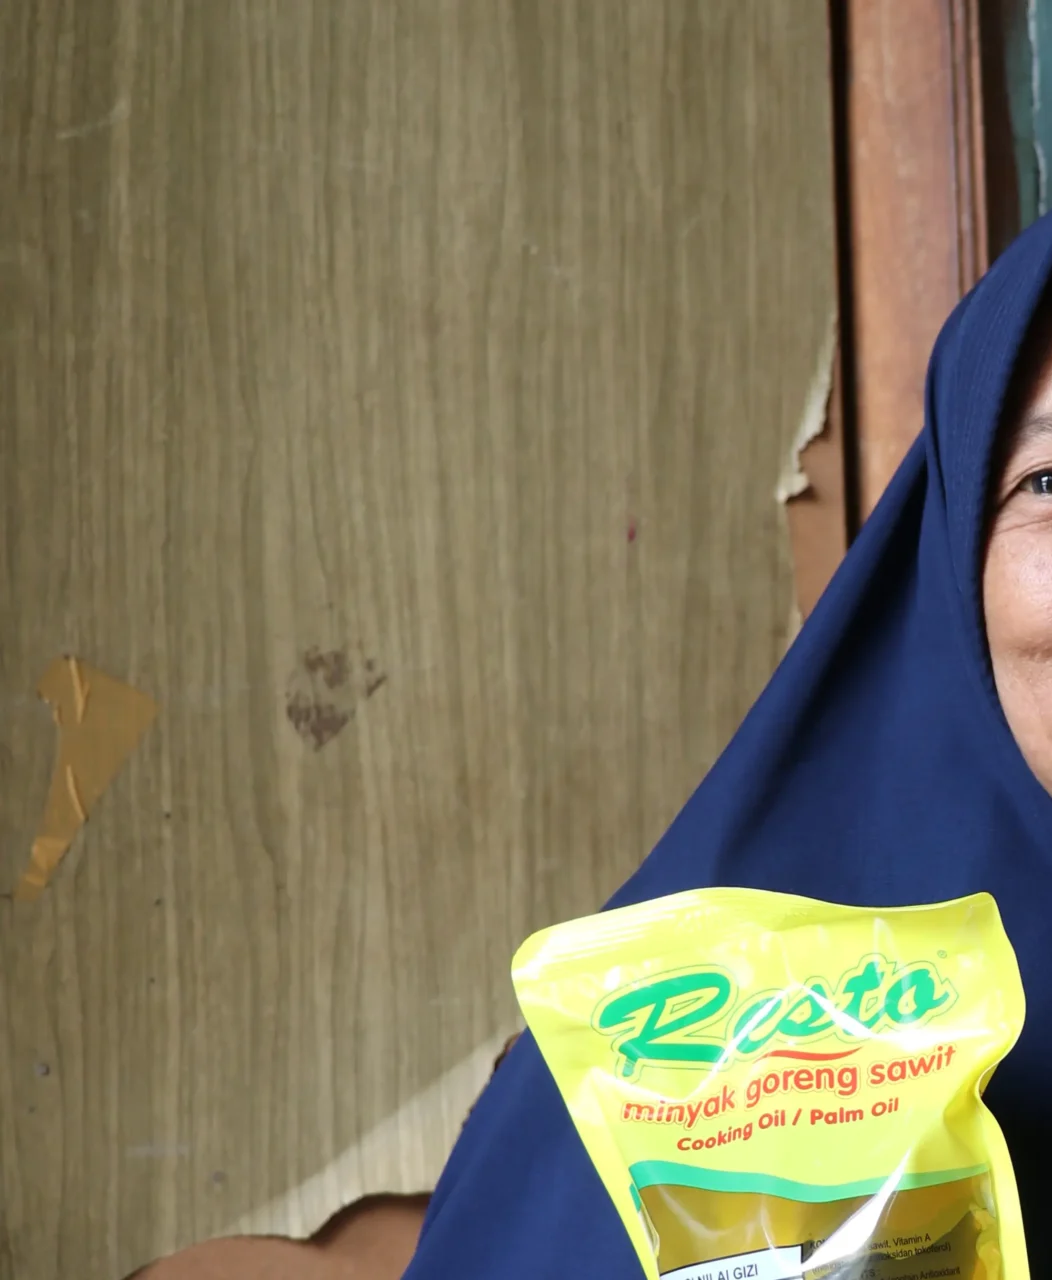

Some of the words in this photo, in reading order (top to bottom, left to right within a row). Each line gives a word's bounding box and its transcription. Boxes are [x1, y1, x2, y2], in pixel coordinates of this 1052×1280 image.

[598, 961, 949, 1077] Resto
[623, 1085, 735, 1128] minyak
[746, 1066, 857, 1108] goreng
[870, 1045, 956, 1084] sawit
[677, 1122, 753, 1151] Cooking
[758, 1109, 786, 1129] Oil
[810, 1106, 864, 1125] Palm
[871, 1097, 899, 1117] Oil
[893, 1233, 923, 1247] Vitamin
[924, 1233, 931, 1243] A
[733, 1263, 758, 1280] GIZI
